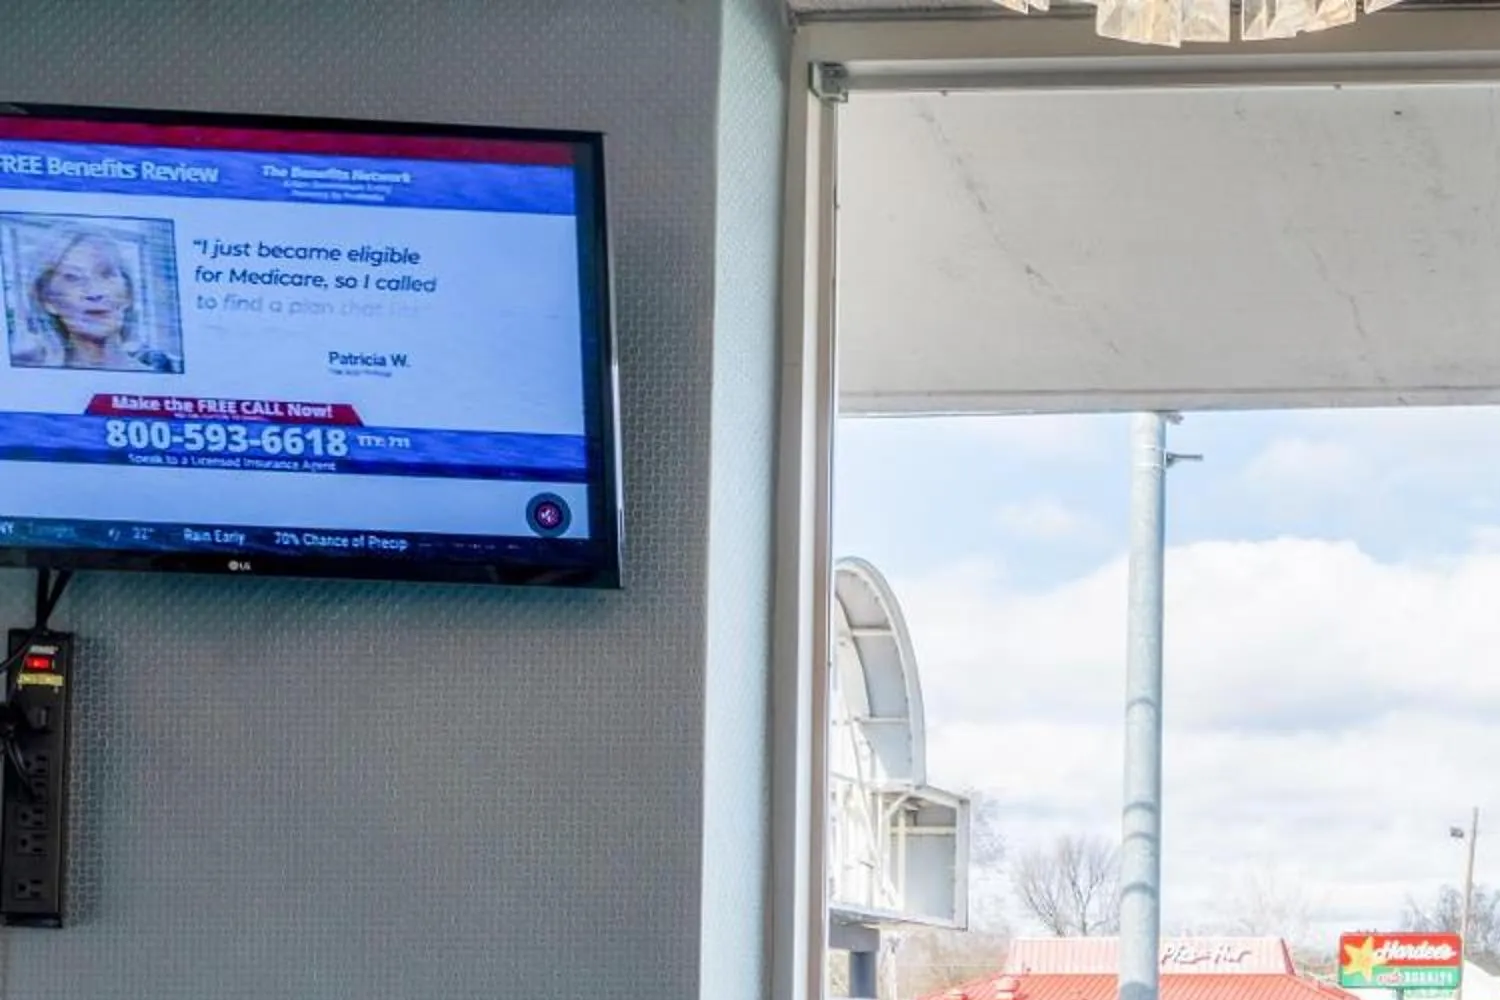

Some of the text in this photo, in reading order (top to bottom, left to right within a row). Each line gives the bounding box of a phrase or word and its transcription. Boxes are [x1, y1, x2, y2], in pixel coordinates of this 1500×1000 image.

[47, 156, 137, 179] Benefits
[141, 161, 220, 183] Review
[262, 165, 288, 177] The
[210, 240, 251, 259] just
[257, 240, 342, 261] became
[347, 245, 421, 267] eligible
[195, 265, 437, 293] for Medicare, so I called
[196, 295, 218, 311] to
[223, 293, 263, 313] find
[269, 298, 283, 313] a
[328, 351, 412, 368] Patricia W.
[111, 396, 160, 411] Make
[163, 397, 193, 413] the
[198, 399, 237, 414] FREE
[241, 400, 284, 416] CALL
[287, 402, 334, 419] Now!
[105, 419, 350, 458] 800-593-6618
[183, 528, 212, 541] Rain
[214, 530, 246, 545] Early
[302, 532, 348, 548] Chance
[351, 534, 364, 547] of
[367, 535, 407, 551] Precip
